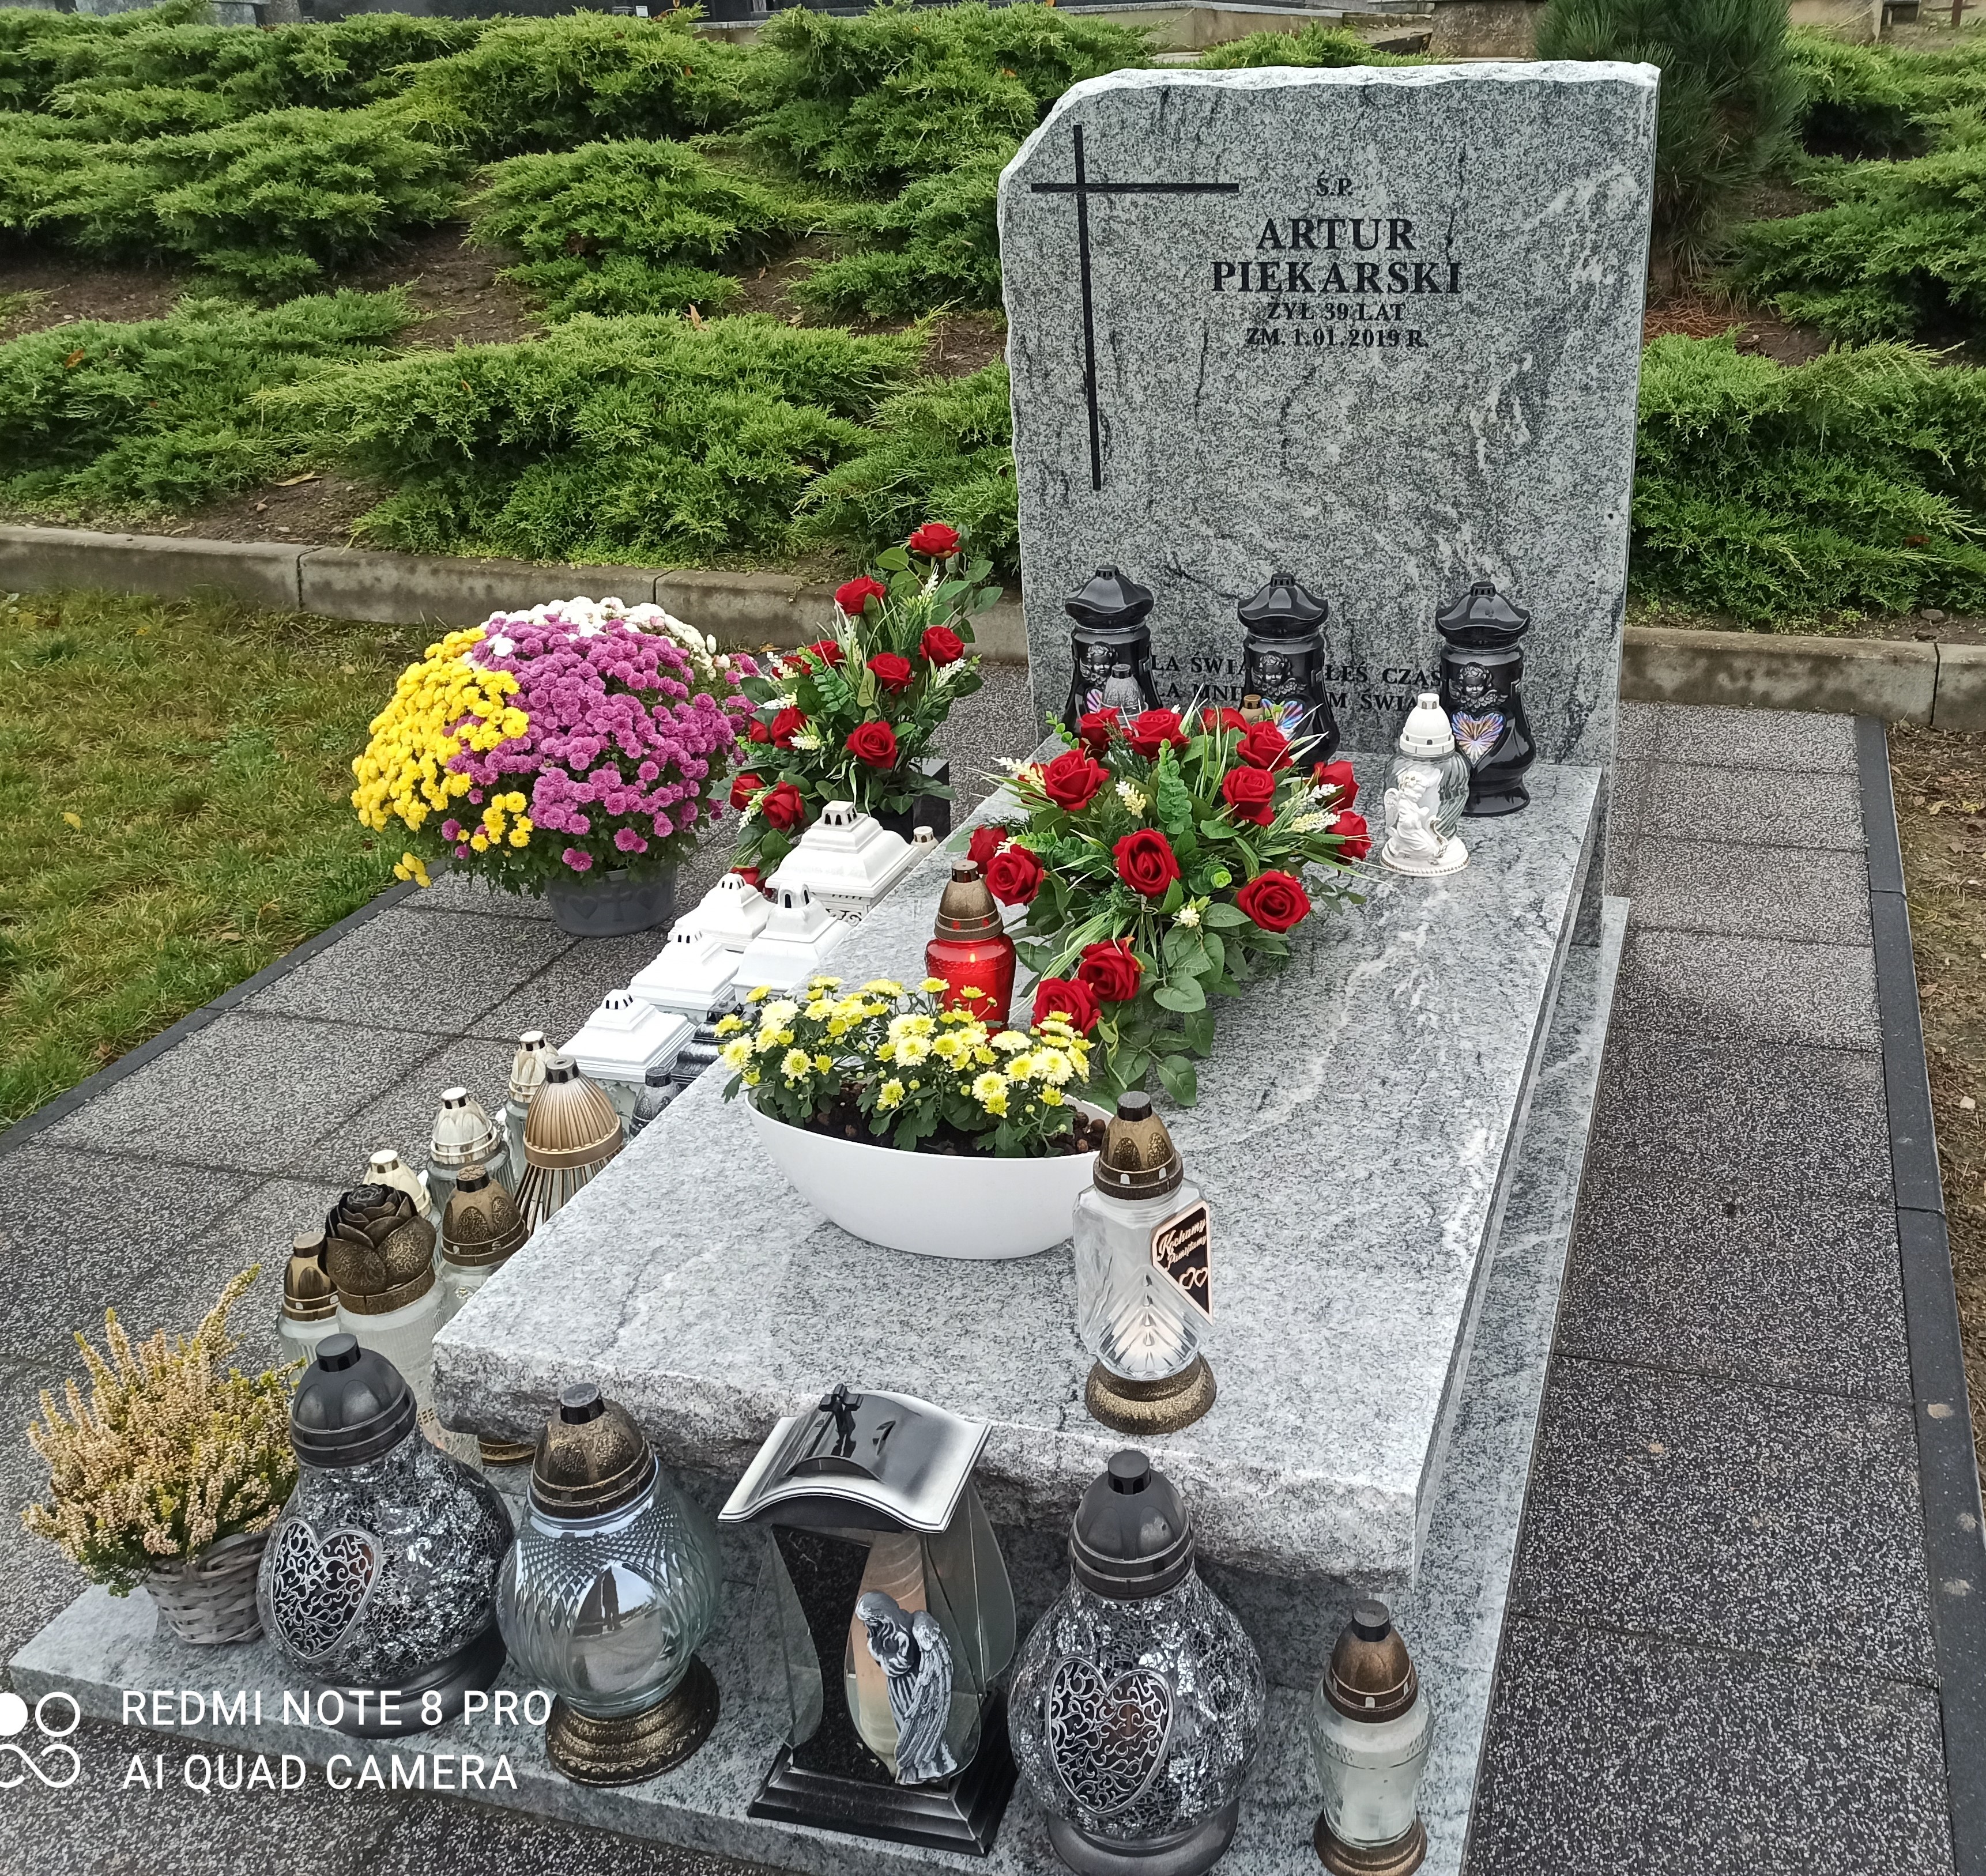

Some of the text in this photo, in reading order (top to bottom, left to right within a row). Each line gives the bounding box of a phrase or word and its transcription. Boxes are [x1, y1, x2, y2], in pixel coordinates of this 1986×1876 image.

[1256, 218, 1416, 250] ARTUR
[1211, 261, 1463, 293] PIEKARSKI
[1326, 303, 1349, 320] 39
[1356, 303, 1405, 321] LAT
[1246, 328, 1429, 347] ZM. 1.01.2019 R.
[1151, 651, 1441, 689] LA ŚWI ŁEŚ CZĄS
[1192, 683, 1243, 701] MNI
